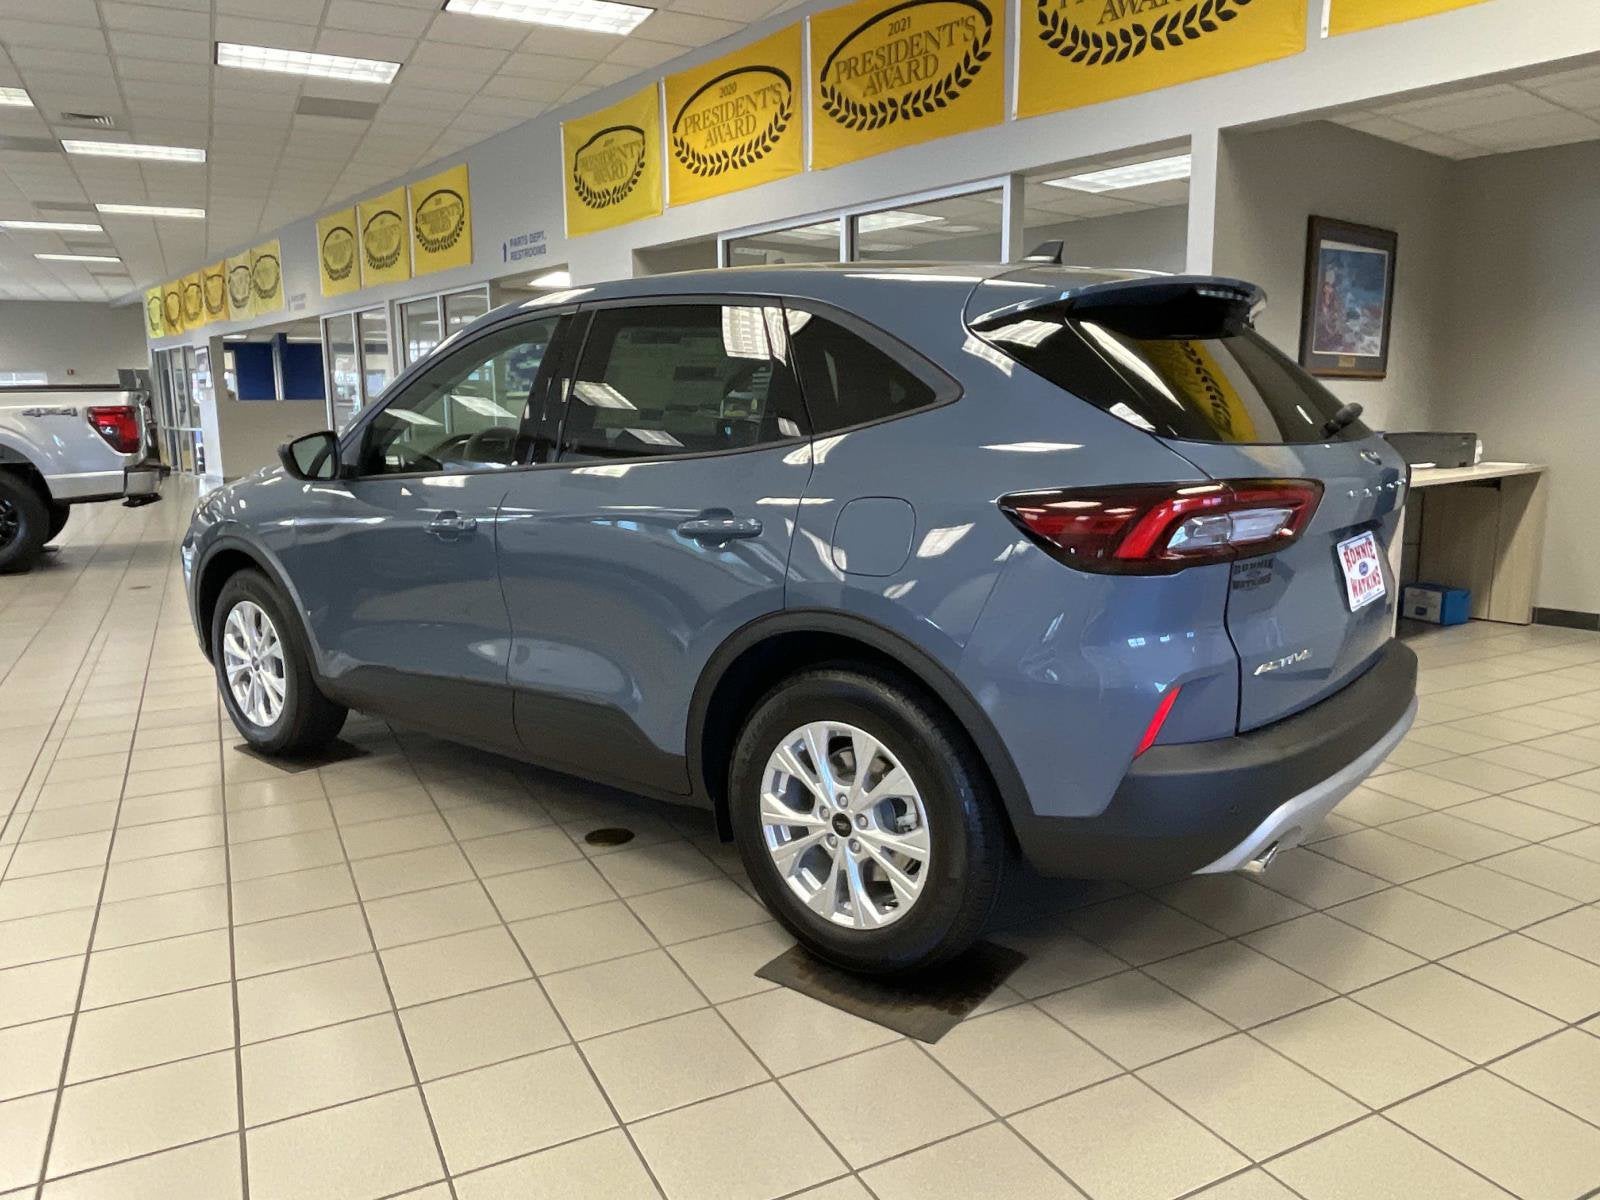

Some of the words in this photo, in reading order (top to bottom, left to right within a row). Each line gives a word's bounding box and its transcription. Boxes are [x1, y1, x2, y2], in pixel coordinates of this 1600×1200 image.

[888, 16, 912, 37] 2021
[835, 15, 977, 84] PRESIDENT'S
[863, 53, 939, 97] AWARD
[683, 82, 783, 136] PRESIDENT'S
[704, 114, 757, 149] AWARD
[1344, 540, 1376, 572] RONNIE
[1349, 566, 1381, 599] WATKINS
